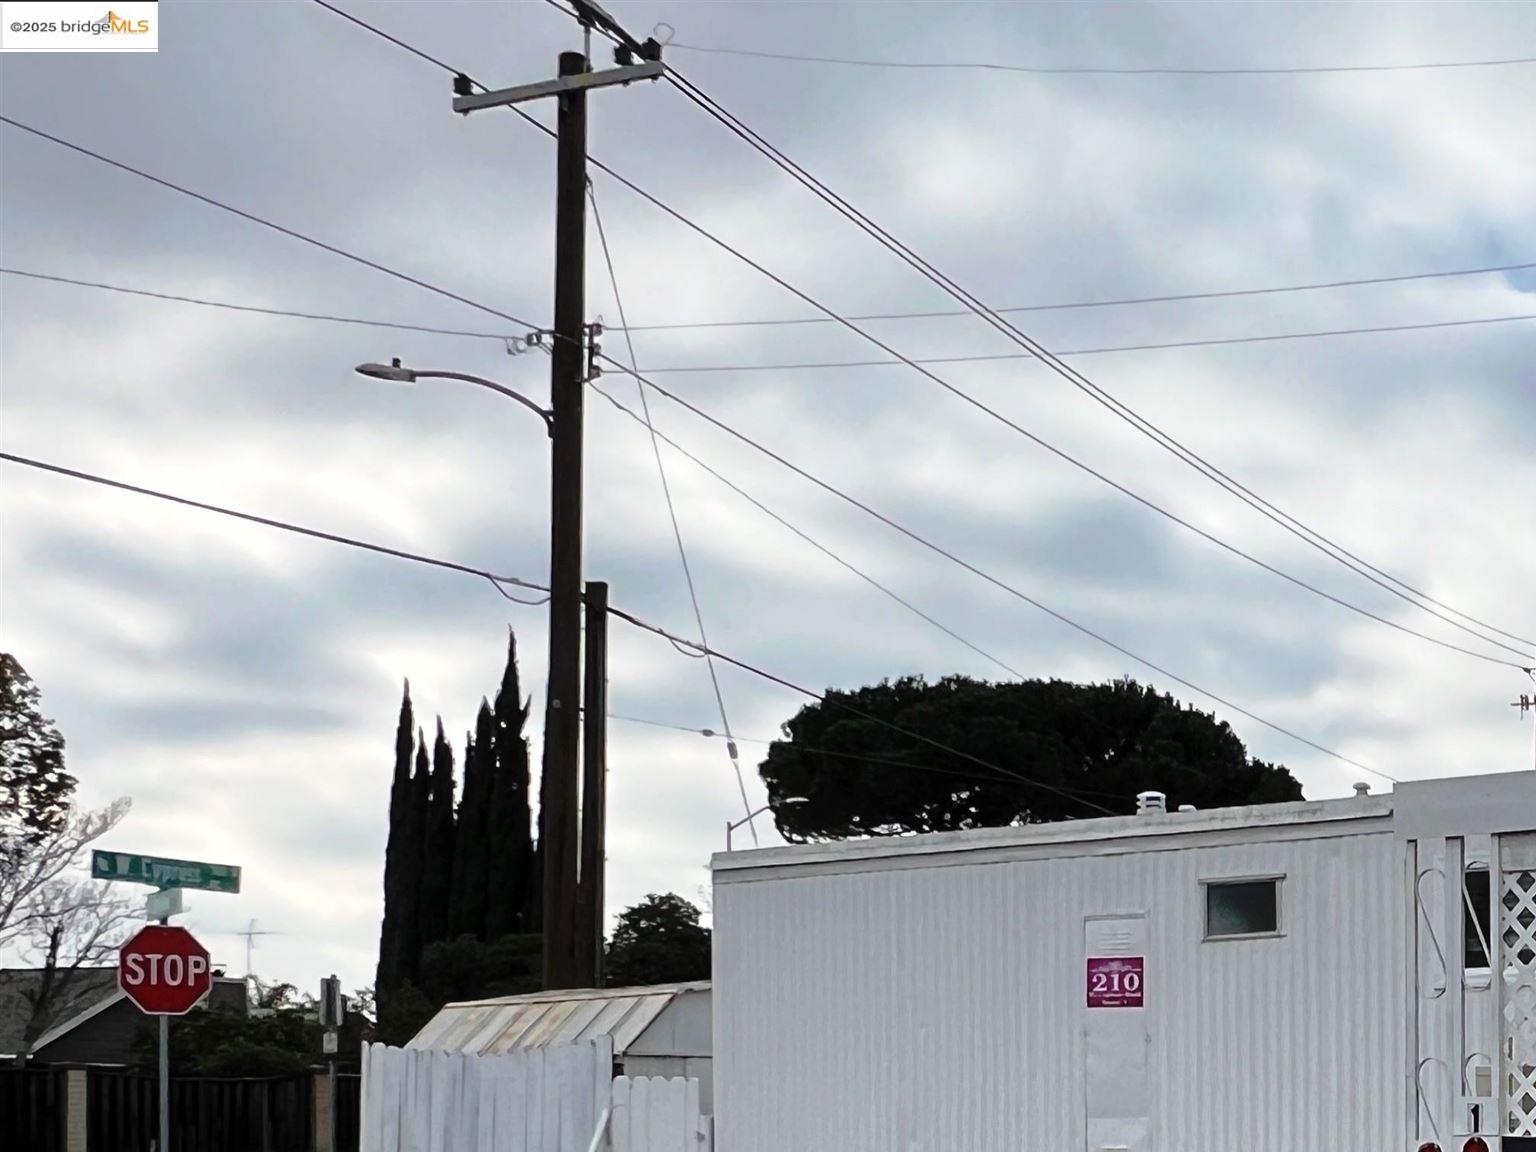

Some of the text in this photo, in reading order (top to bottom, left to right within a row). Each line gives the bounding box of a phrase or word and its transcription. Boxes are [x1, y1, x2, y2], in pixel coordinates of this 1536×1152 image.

[125, 953, 207, 987] STOP
[1092, 972, 1140, 992] 210
[1470, 1103, 1480, 1133] 1
